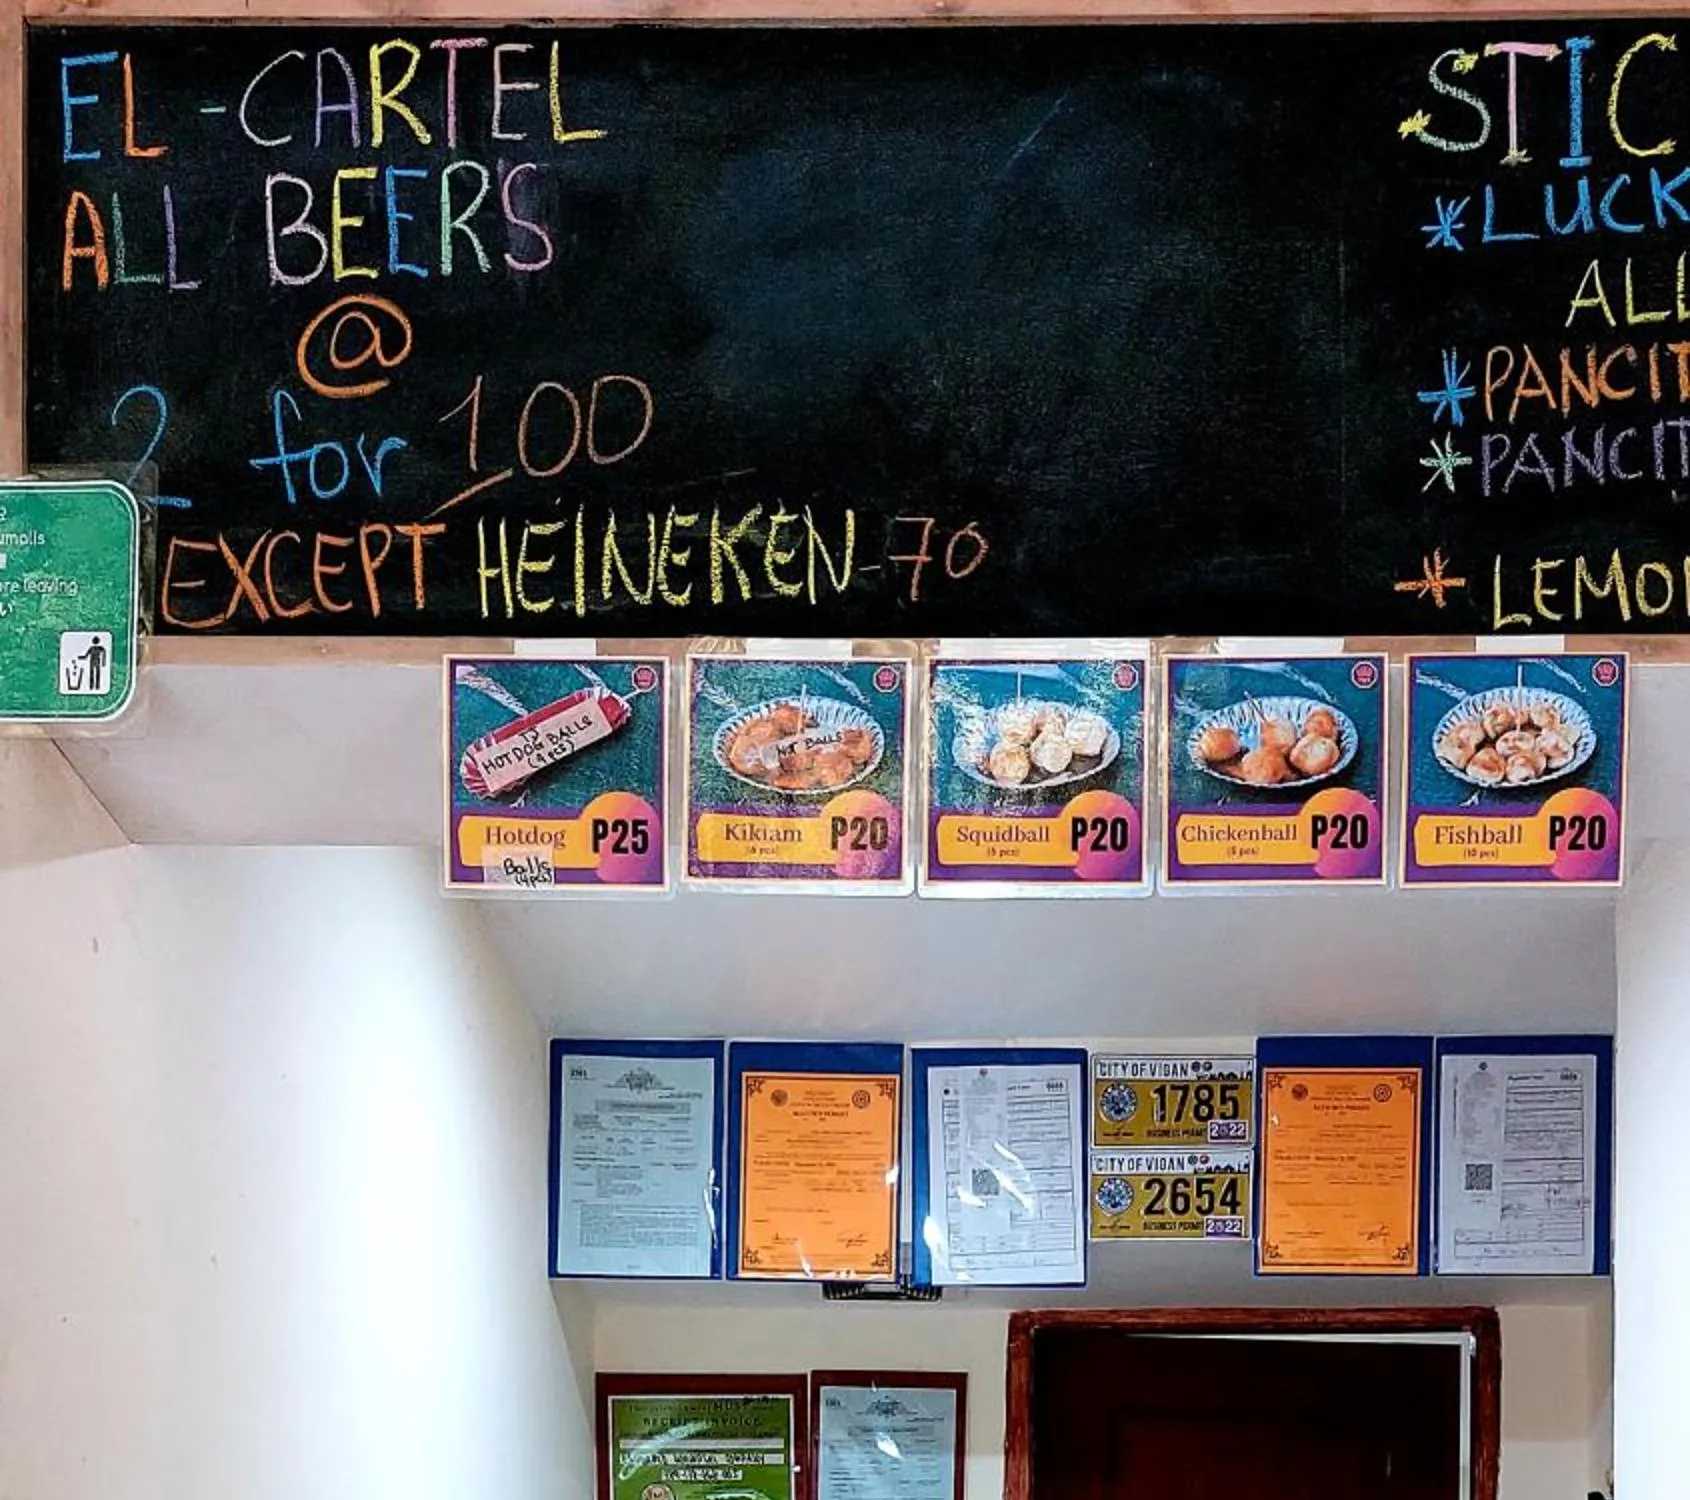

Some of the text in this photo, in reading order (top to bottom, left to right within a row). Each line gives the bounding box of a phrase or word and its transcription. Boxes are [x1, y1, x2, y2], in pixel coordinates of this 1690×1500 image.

[61, 52, 168, 163] EL
[1397, 33, 1679, 168] STIC
[61, 160, 555, 293] ALL BEERS
[296, 294, 413, 399] @
[111, 374, 654, 520] 2 for 100
[162, 521, 447, 628] EXCEPT
[1493, 547, 1690, 631] LEMO
[485, 818, 649, 855] Hotdog P25
[724, 816, 889, 851] Kikiam P20
[956, 816, 1129, 852] Squidball P20
[1181, 814, 1369, 850] Chickenball P20
[1434, 815, 1607, 851] Fishball P20
[1100, 1063, 1129, 1077] CITY
[1132, 1063, 1146, 1077] OF
[1152, 1084, 1240, 1123] 1785
[1211, 1124, 1246, 1138] 2022
[1096, 1157, 1125, 1171] CITY
[1128, 1157, 1142, 1171] OF
[1142, 1178, 1241, 1216] 2654
[1207, 1221, 1241, 1233] 2022
